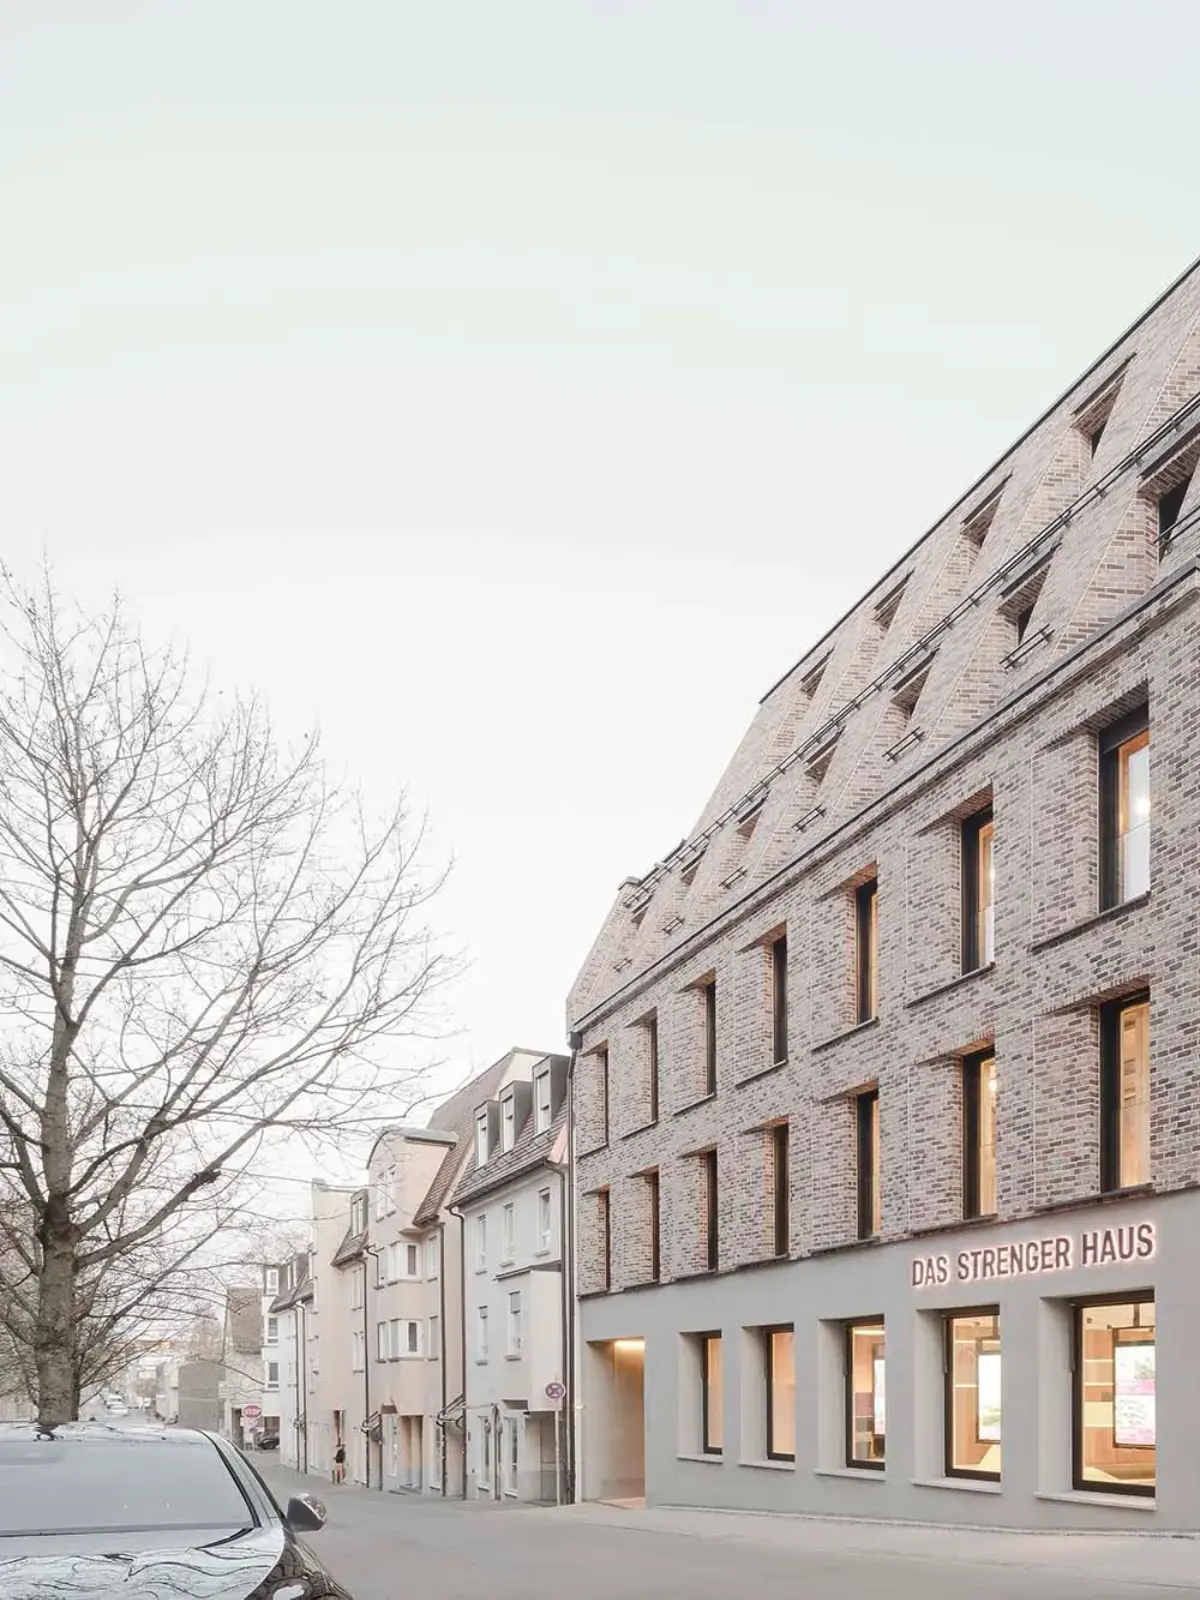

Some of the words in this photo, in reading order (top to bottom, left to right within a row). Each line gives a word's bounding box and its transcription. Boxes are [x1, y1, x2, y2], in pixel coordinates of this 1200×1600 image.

[911, 1257, 948, 1286] DAS
[957, 1238, 1071, 1280] STRENGER
[1081, 1224, 1154, 1265] HAUS
